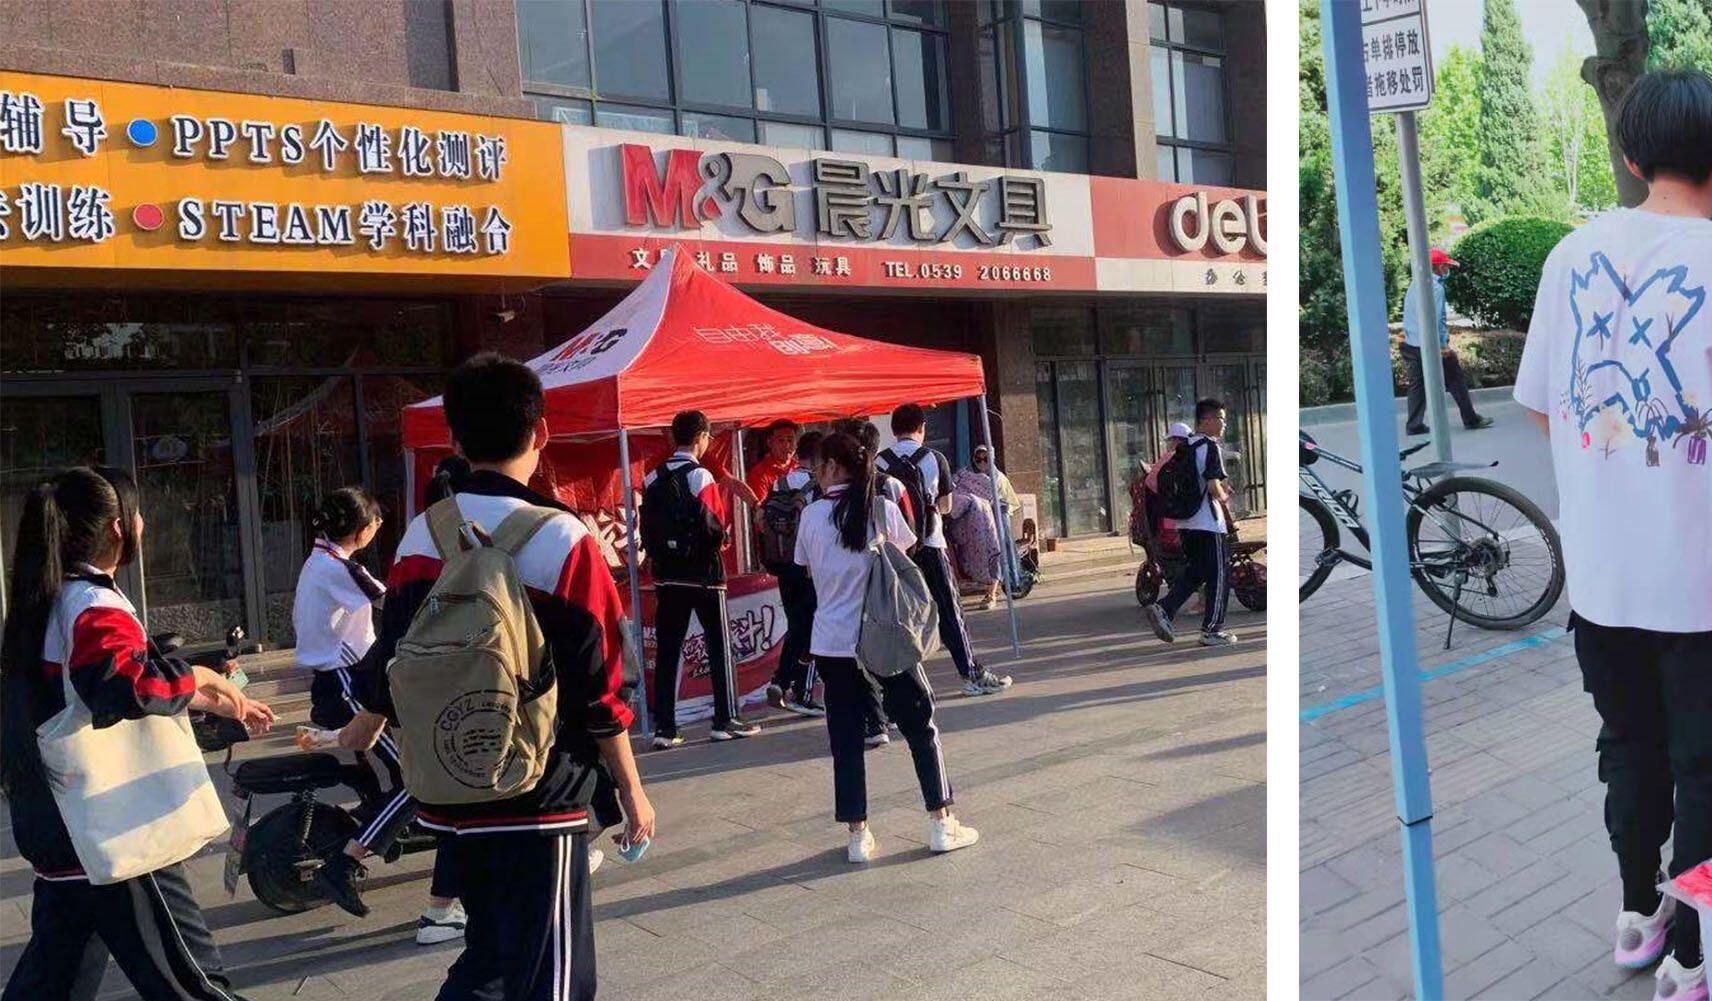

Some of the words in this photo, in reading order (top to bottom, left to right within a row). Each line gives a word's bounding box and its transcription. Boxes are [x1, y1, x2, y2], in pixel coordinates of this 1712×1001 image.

[619, 143, 796, 233] M&G
[814, 157, 1053, 248] 晨光文具
[757, 253, 797, 275] 饰品
[814, 256, 851, 276] 玩具
[884, 261, 963, 280] TEL.0539
[979, 265, 1052, 281] 2066668
